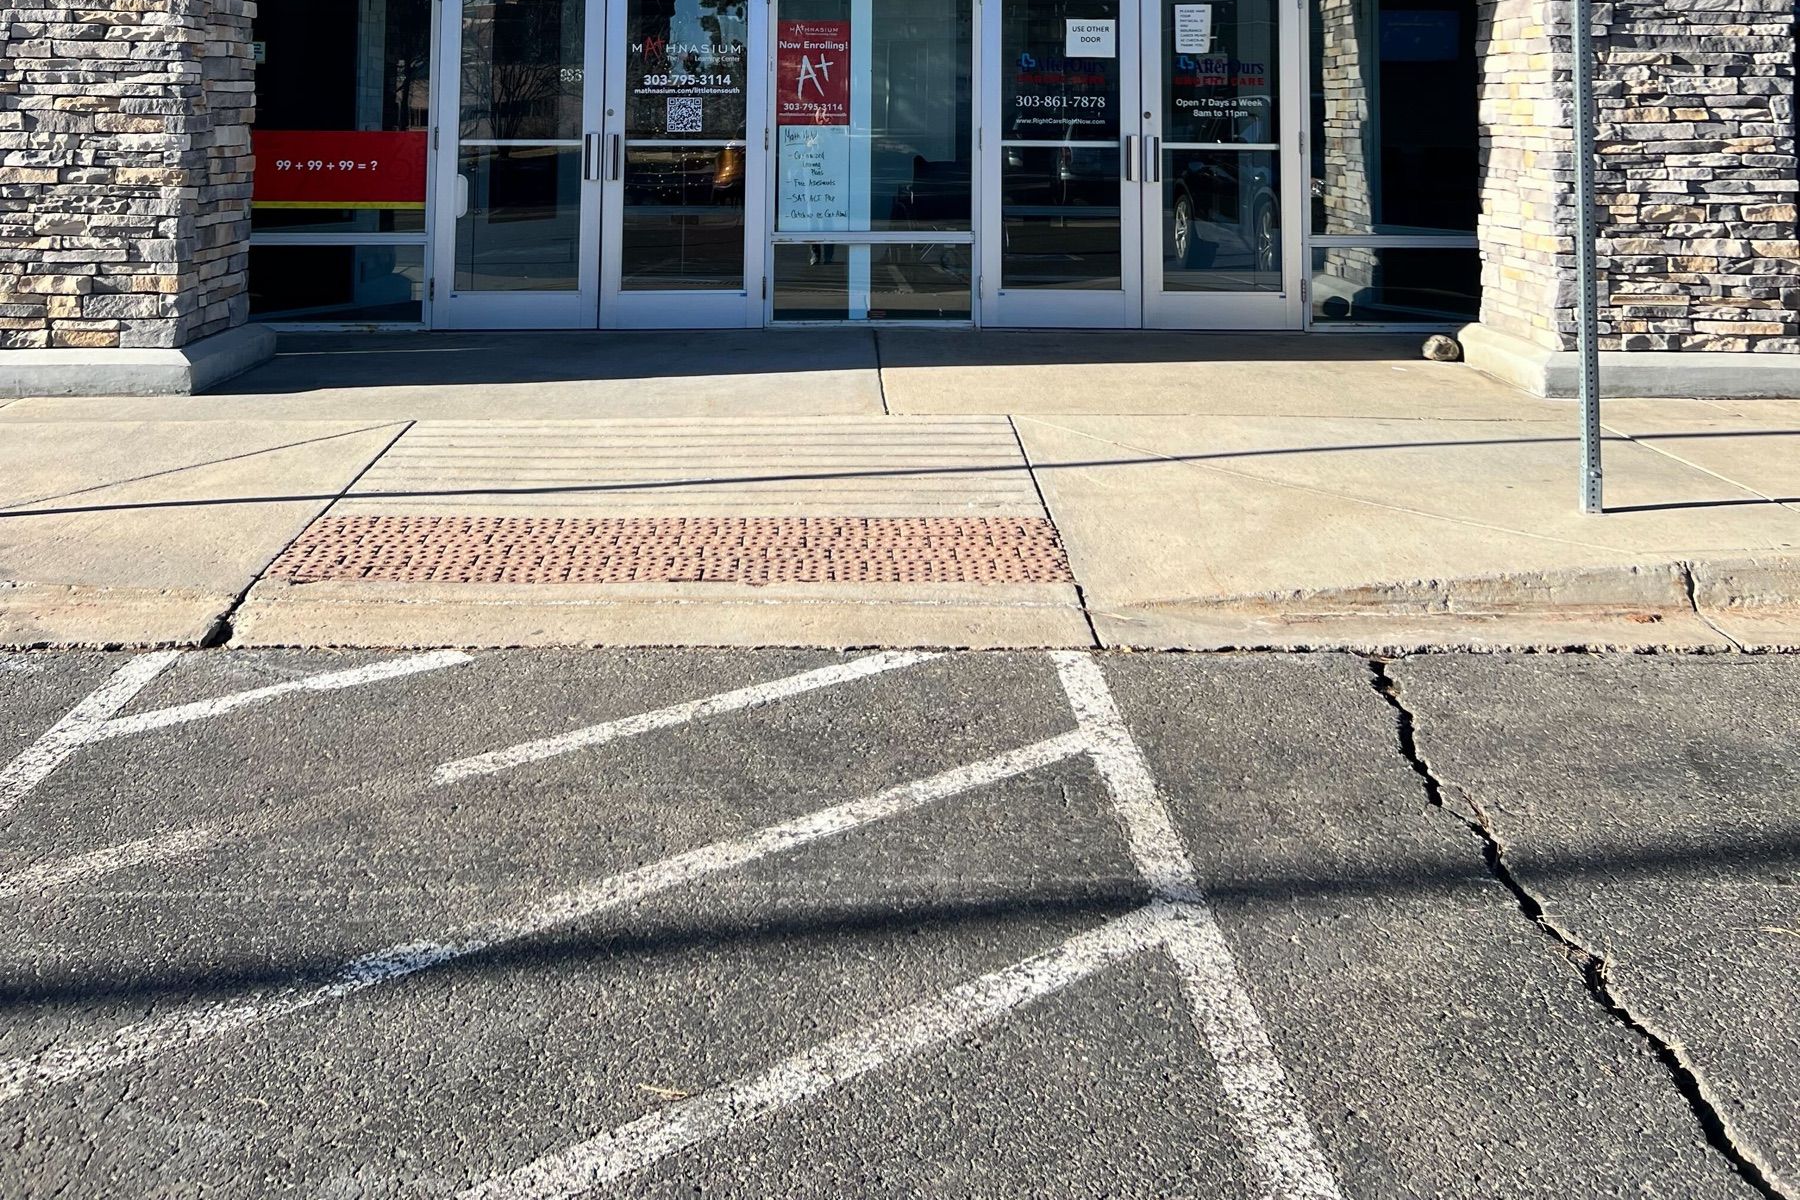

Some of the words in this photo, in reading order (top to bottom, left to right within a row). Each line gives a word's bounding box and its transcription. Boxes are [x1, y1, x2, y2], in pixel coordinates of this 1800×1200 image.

[779, 41, 801, 50] Now
[803, 41, 849, 52] Enrolling!
[643, 74, 732, 86] 303-795-3114
[796, 53, 834, 100] A+
[634, 86, 741, 95] mathnasium.com/littletonsouth
[1015, 95, 1106, 107] 303-861-7878
[1176, 98, 1200, 108] Open
[1208, 99, 1230, 108] Days
[1238, 99, 1263, 107] Week
[1193, 109, 1212, 117] 8am
[1225, 109, 1249, 119] 11pm
[276, 160, 292, 171] 99
[307, 160, 323, 171] 99
[339, 160, 354, 171] 99
[370, 160, 378, 171] ?
